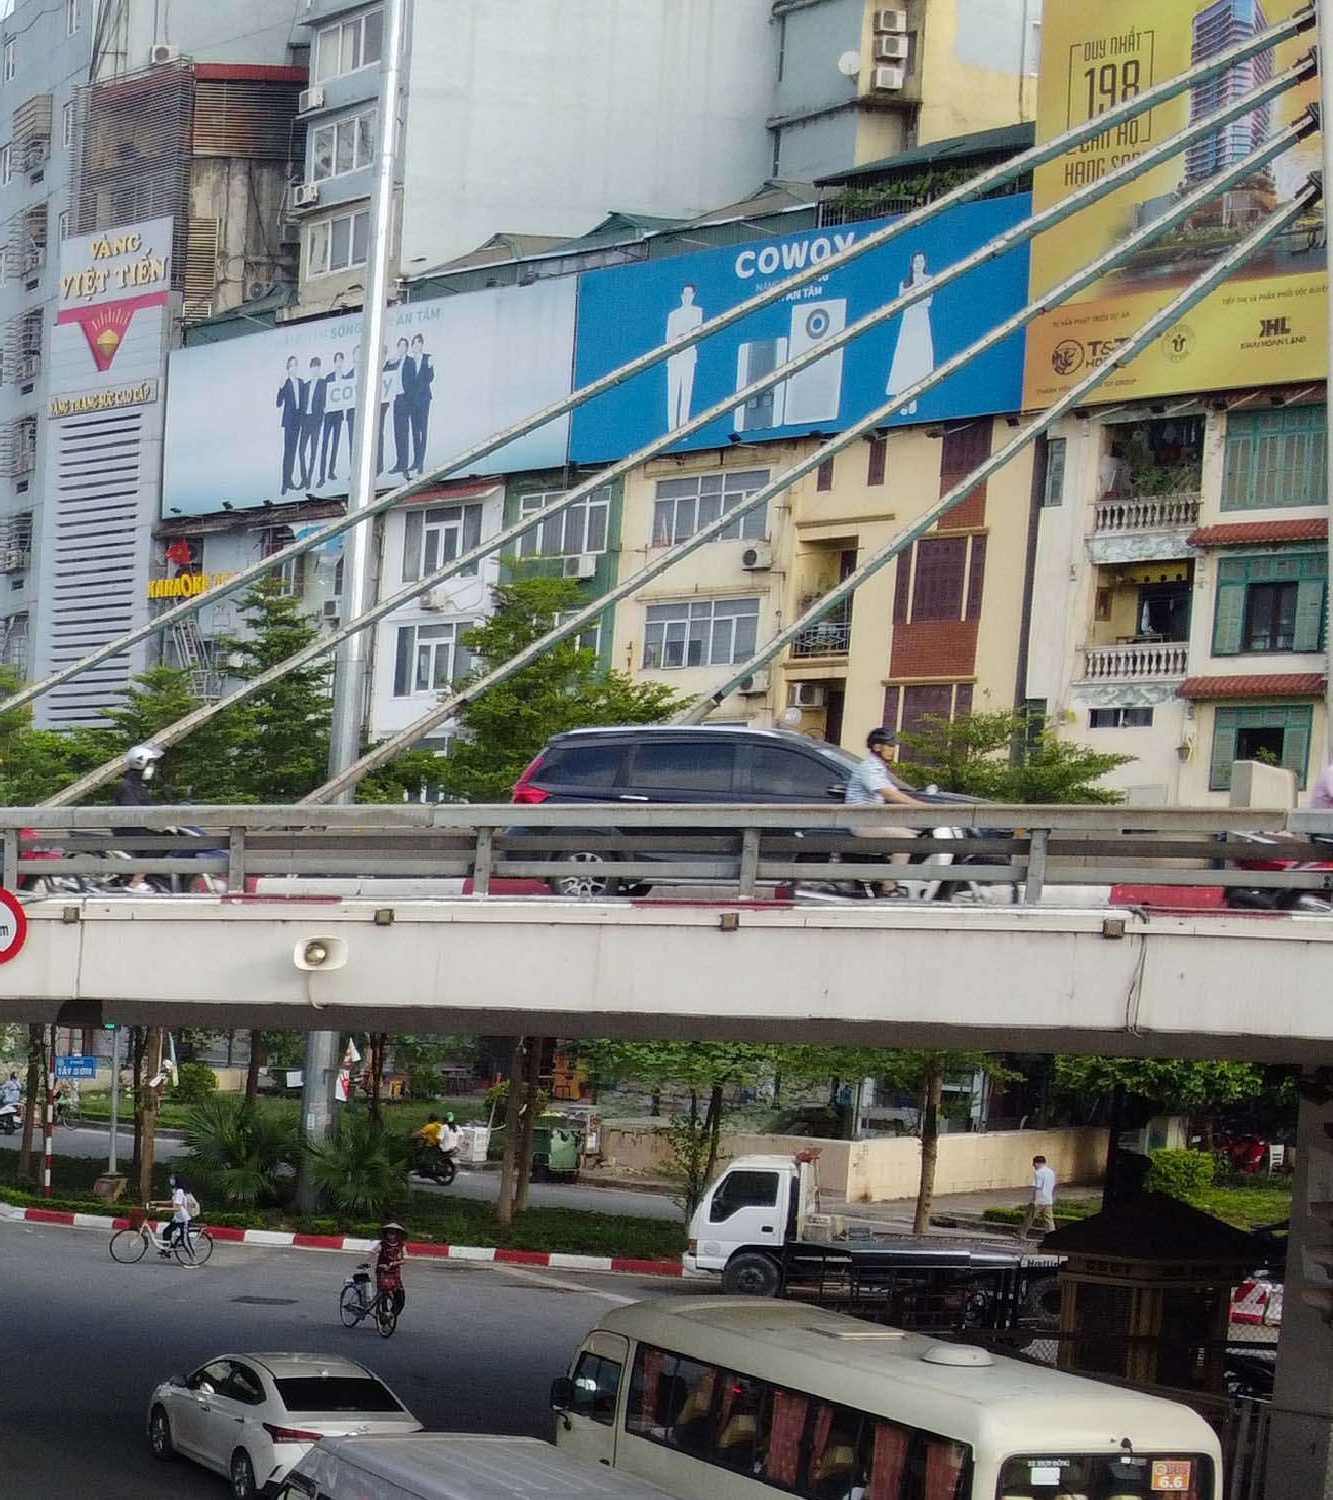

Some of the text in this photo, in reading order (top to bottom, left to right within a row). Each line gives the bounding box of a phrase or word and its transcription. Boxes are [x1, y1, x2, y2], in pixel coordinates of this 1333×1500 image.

[90, 233, 143, 261] VÀNG
[61, 248, 170, 301] VIỆT TIẾN
[1159, 1476, 1184, 1489] 6.6
